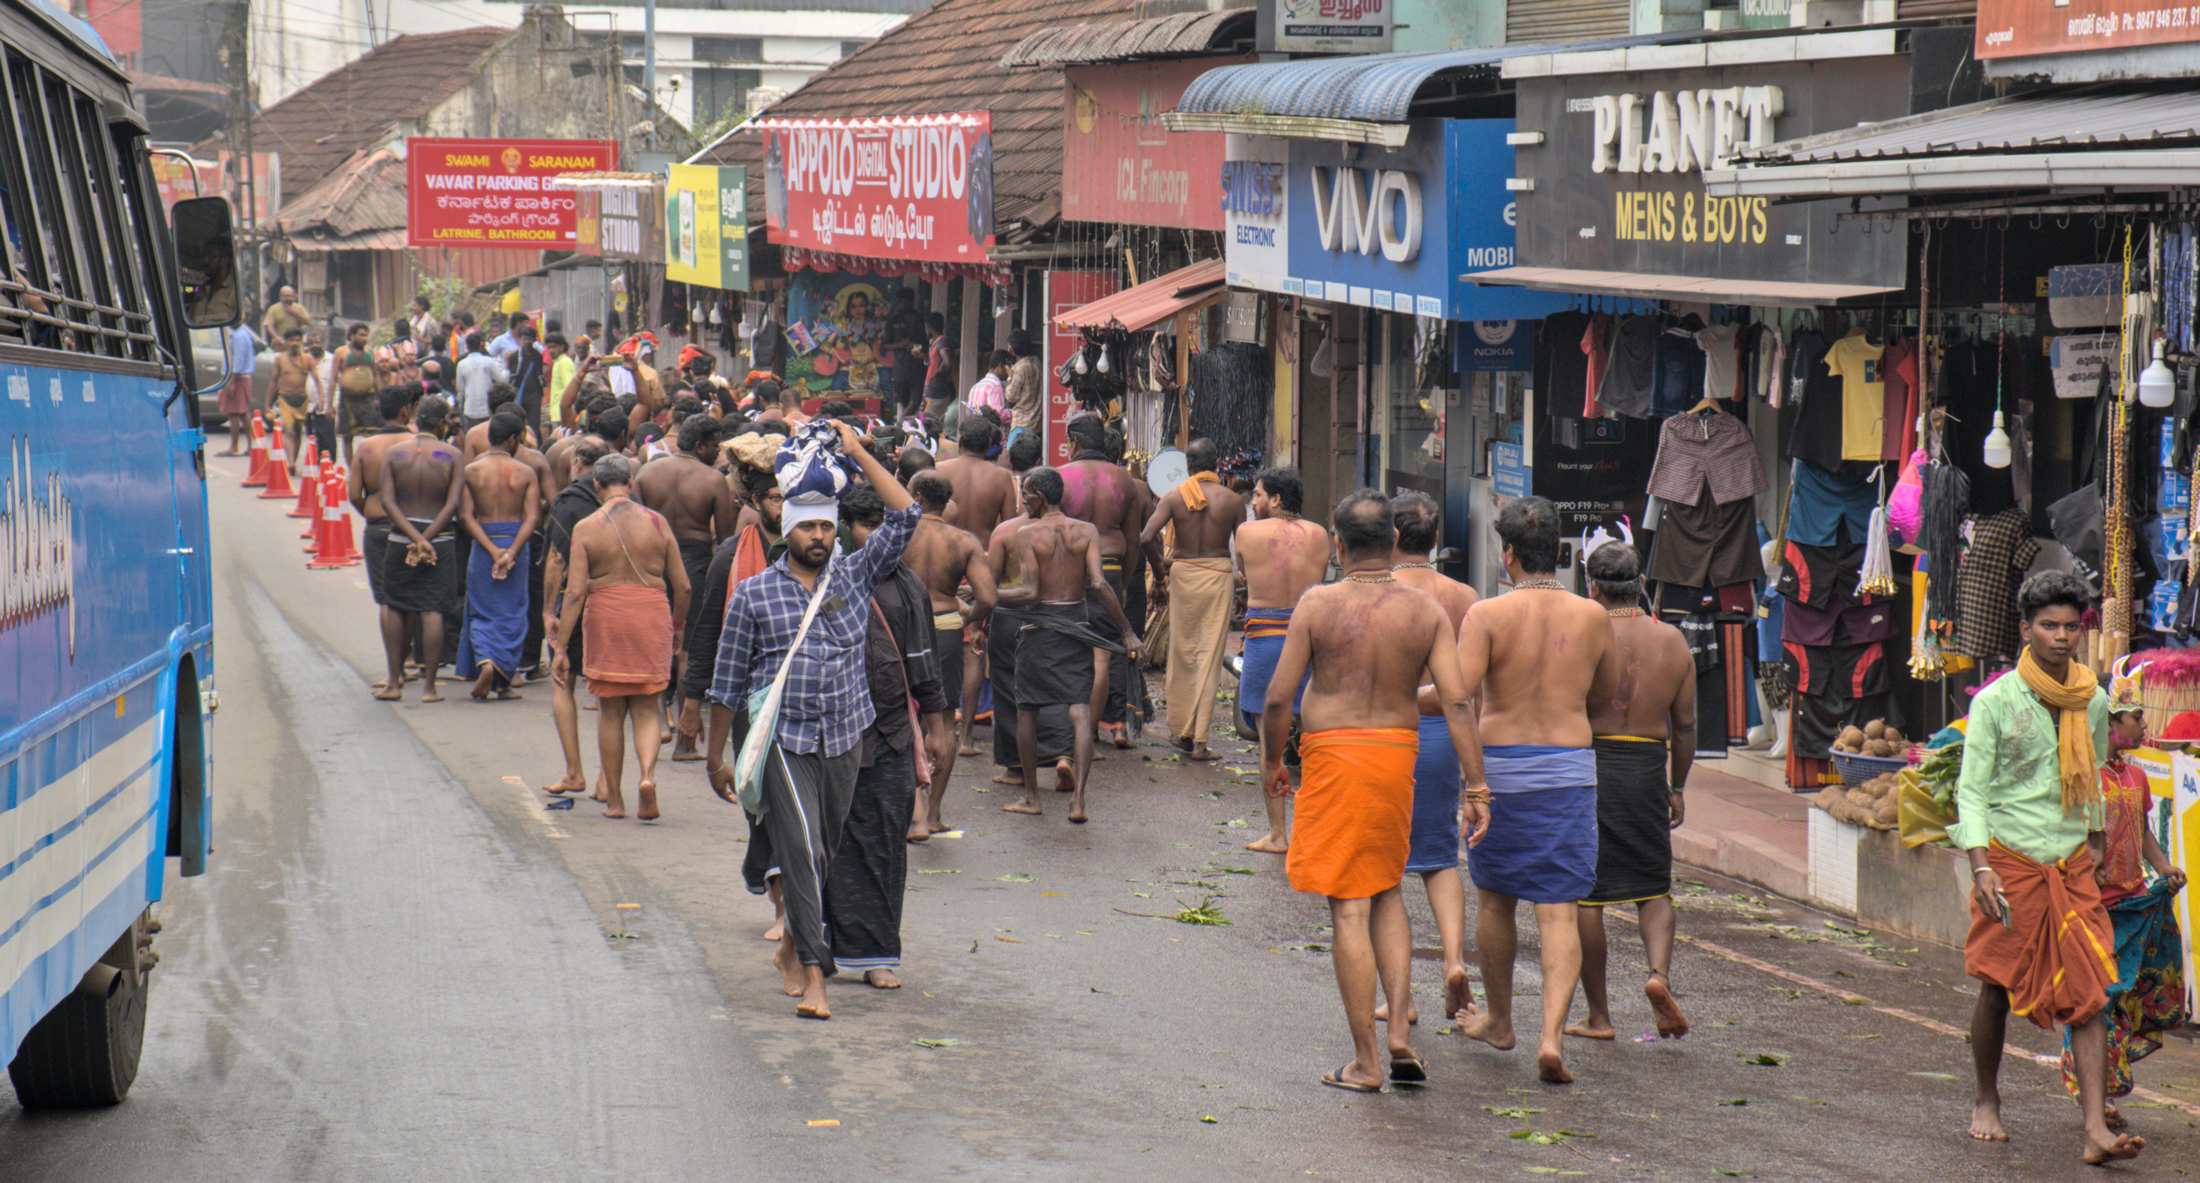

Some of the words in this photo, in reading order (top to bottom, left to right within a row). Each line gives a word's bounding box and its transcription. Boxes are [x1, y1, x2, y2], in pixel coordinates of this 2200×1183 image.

[2136, 10, 2154, 30] 9847
[2156, 9, 2170, 28] 946
[1591, 85, 1784, 174] PLANET
[445, 154, 490, 167] SWAMI
[528, 155, 596, 168] SARANAM
[788, 126, 855, 197] APPOLO
[857, 142, 888, 177] DIGITAL
[890, 127, 966, 200] STUDIO
[425, 174, 473, 190] VAVAR
[477, 175, 538, 191] PARKING
[1117, 157, 1137, 201] ICL
[1139, 158, 1189, 218] Fincorp
[1615, 191, 1676, 241] MENS
[1681, 191, 1698, 243] &
[1703, 193, 1768, 244] BOYS
[433, 228, 485, 240] LATRINE,
[488, 229, 556, 241] BATHROOM
[602, 218, 640, 254] STUDIO
[1236, 224, 1276, 248] ELECTRONIC
[1473, 347, 1515, 356] NOKIA
[1577, 501, 1592, 510] F19
[1573, 514, 1588, 522] F19
[1589, 514, 1602, 522] Pro
